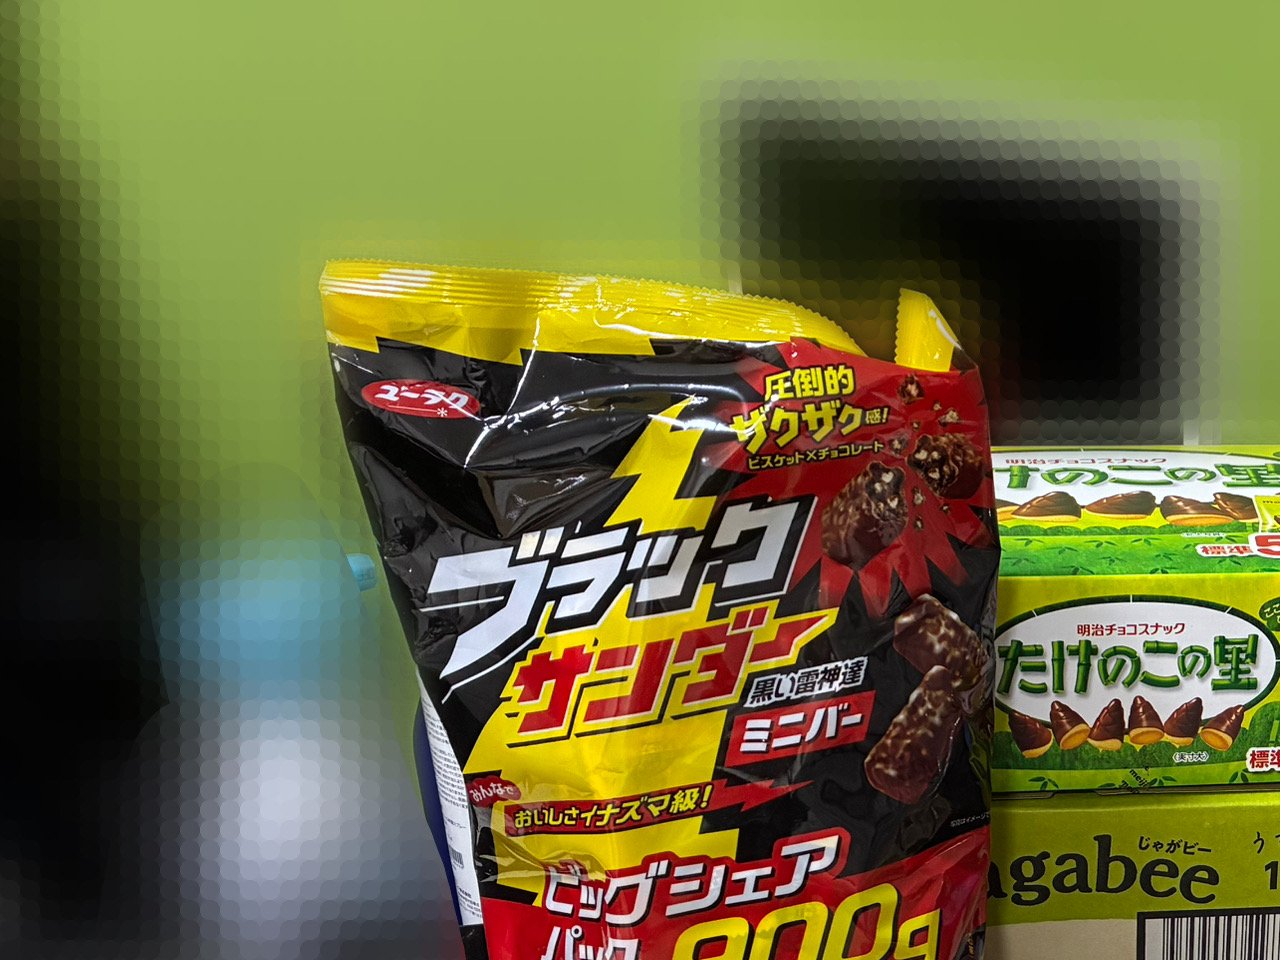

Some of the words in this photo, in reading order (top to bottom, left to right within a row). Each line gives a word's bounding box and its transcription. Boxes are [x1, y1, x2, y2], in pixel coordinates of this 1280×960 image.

[765, 365, 855, 402] 圧倒的
[729, 399, 890, 455] ザクザク感!
[748, 441, 884, 470] ビスケット×チョコレート
[427, 500, 801, 680] ブラック
[1076, 621, 1186, 637] 明治チョコスナック
[513, 607, 830, 735] サンダー
[748, 659, 866, 706] 黒い雷神達
[997, 632, 1259, 696] たけのこの里
[739, 703, 862, 753] ミニバー
[469, 781, 515, 802] みんなで
[514, 784, 713, 828] おいしさイナズマ級!
[1138, 835, 1212, 855] じゃがビー
[545, 834, 840, 926] ビッグシェア
